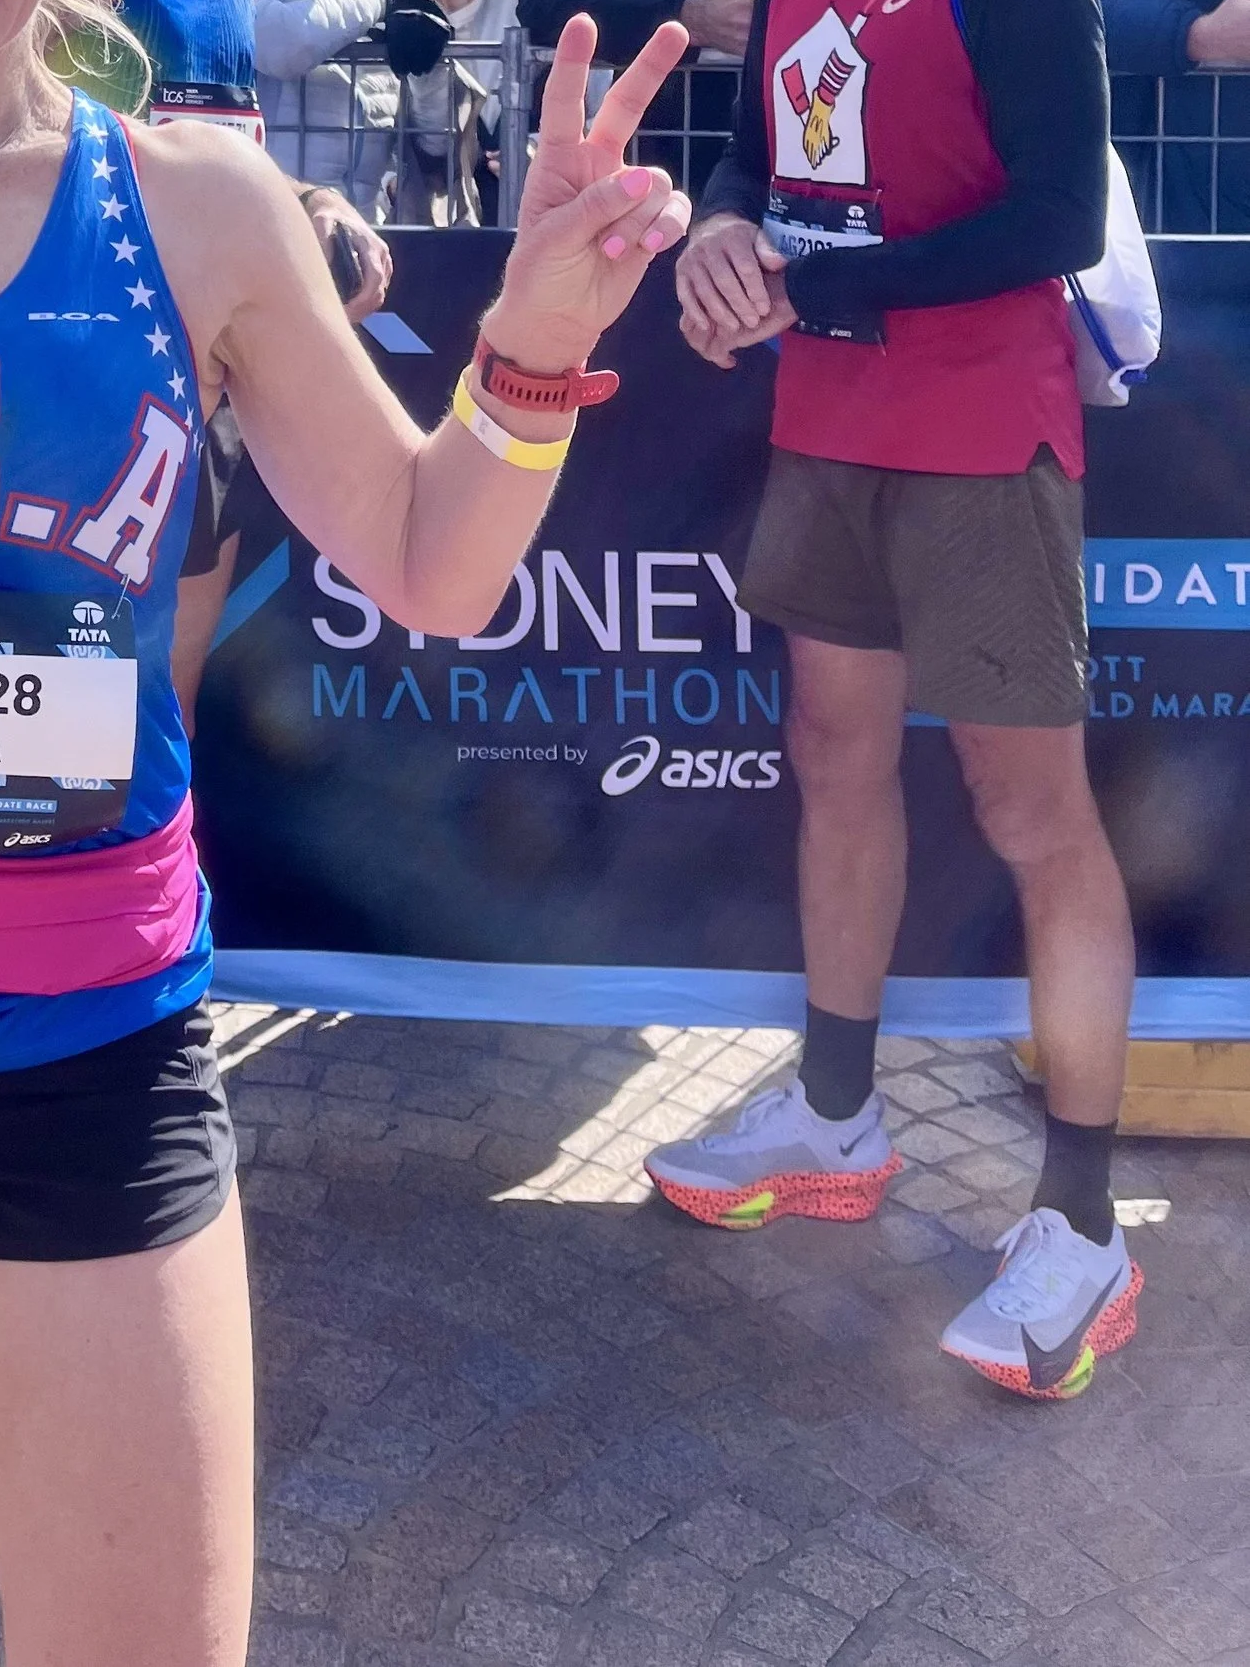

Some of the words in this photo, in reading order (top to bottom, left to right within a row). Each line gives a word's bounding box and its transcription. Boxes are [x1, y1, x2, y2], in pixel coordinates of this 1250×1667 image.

[163, 87, 184, 104] tcs
[845, 219, 868, 228] TATA
[311, 550, 752, 653] SDNEY
[67, 628, 111, 643] TATA
[312, 664, 781, 726] MARATHON
[457, 743, 558, 763] presented
[564, 744, 588, 766] by
[661, 750, 782, 790] asics
[26, 802, 53, 811] RACE
